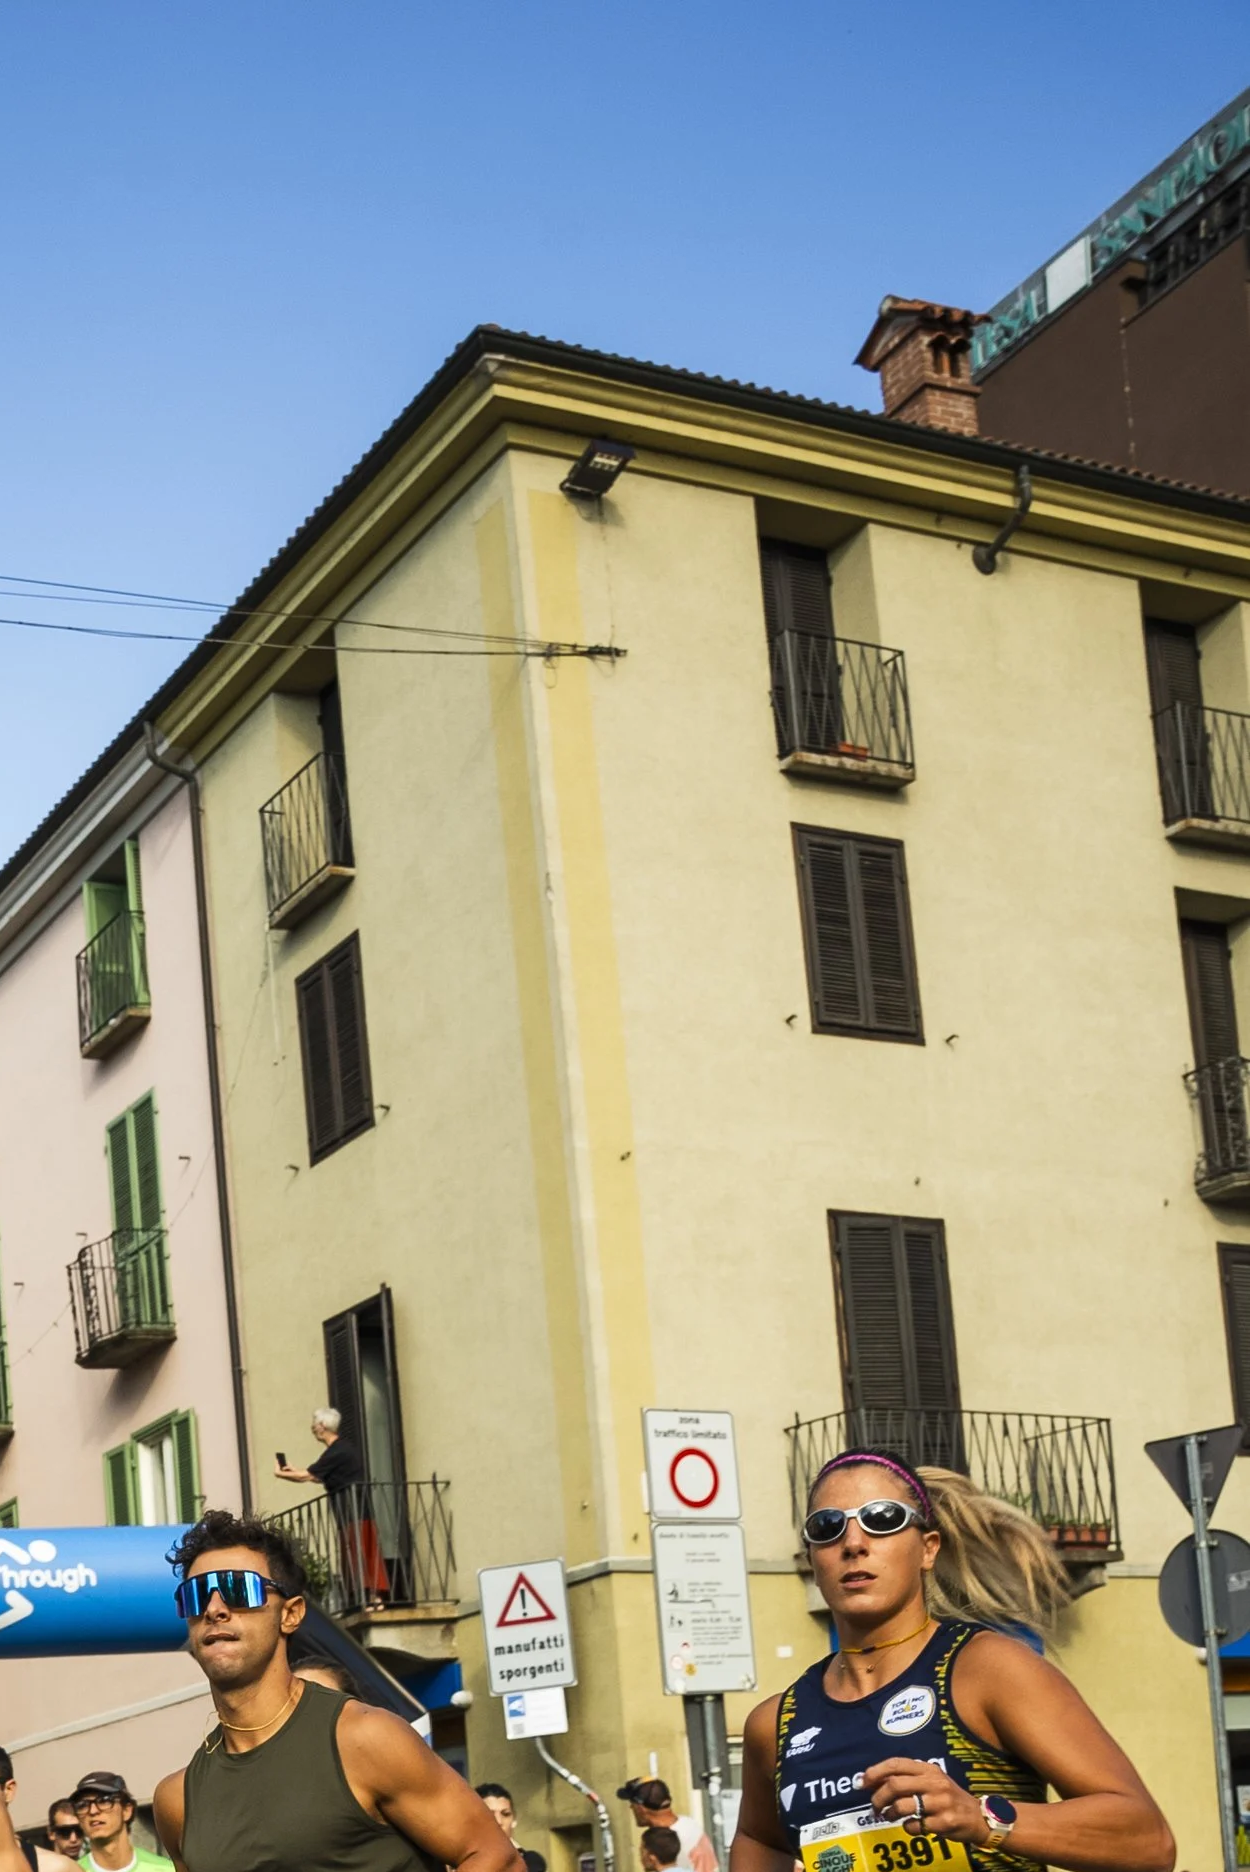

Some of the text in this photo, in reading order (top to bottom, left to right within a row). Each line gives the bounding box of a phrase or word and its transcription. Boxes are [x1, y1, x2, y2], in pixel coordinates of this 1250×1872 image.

[494, 1634, 565, 1656] manufatti
[499, 1658, 565, 1682] sporgenti
[812, 1852, 857, 1870] CINQUE
